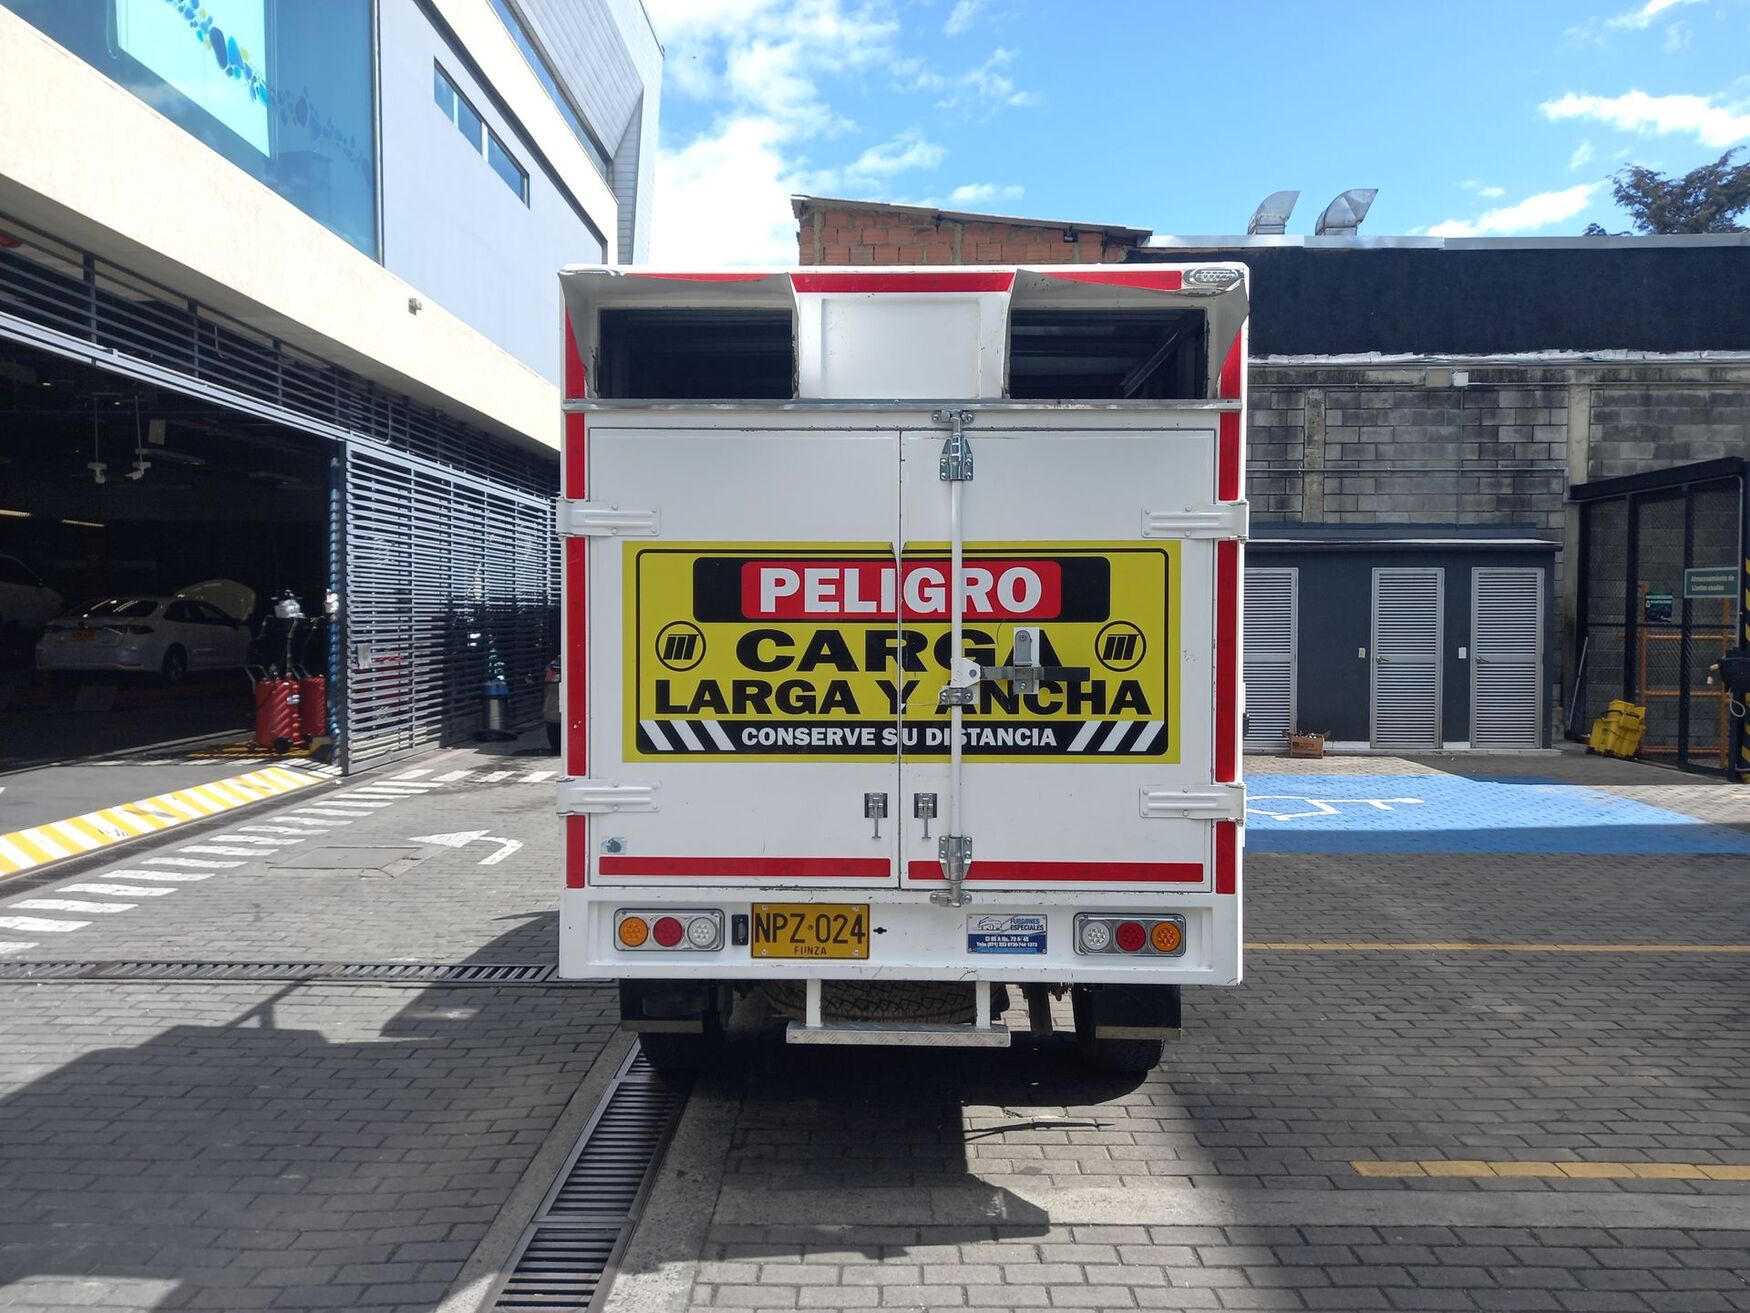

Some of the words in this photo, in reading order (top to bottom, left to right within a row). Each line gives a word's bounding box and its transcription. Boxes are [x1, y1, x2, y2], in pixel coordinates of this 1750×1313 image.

[759, 566, 1042, 613] PELIGRO
[655, 679, 861, 715] LARGA
[875, 679, 921, 715] Y
[741, 727, 876, 746] CONSERVE
[881, 727, 918, 746] SU
[925, 727, 1057, 746] DISTANCIA
[794, 946, 827, 956] FUNZA
